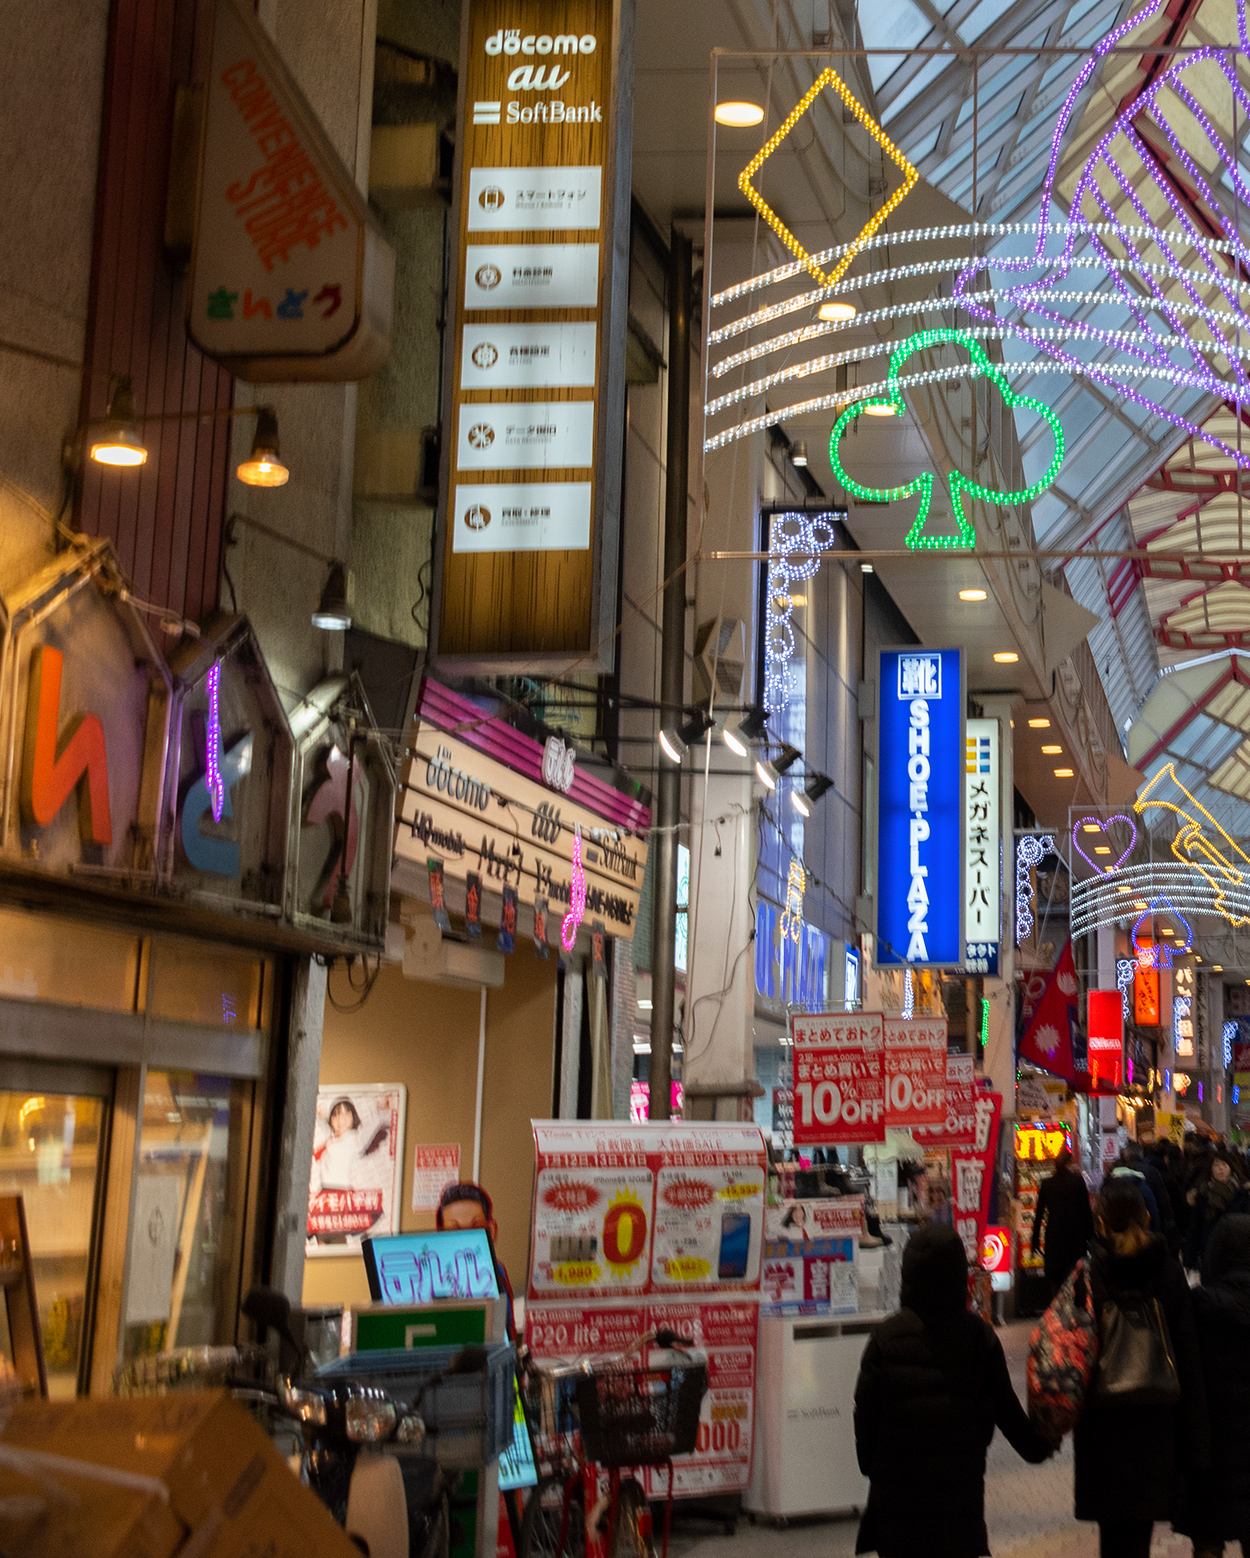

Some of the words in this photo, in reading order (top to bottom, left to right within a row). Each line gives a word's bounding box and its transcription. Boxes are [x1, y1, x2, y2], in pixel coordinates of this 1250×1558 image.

[485, 29, 597, 56] docomo
[507, 64, 570, 91] au
[506, 101, 603, 124] SoftBank
[902, 657, 937, 695] 靴
[426, 745, 491, 811] docomo
[532, 801, 562, 844] au
[969, 780, 992, 925] メガネスーパー
[795, 1026, 881, 1043] まとめておトク
[798, 1063, 881, 1079] まとめ買いで
[795, 1080, 857, 1127] 10%
[841, 1099, 884, 1125] OFF
[912, 1088, 946, 1111] OFF
[946, 1114, 975, 1134] OFF
[602, 1202, 647, 1264] 0
[531, 1324, 567, 1346] P20
[574, 1323, 600, 1344] lite
